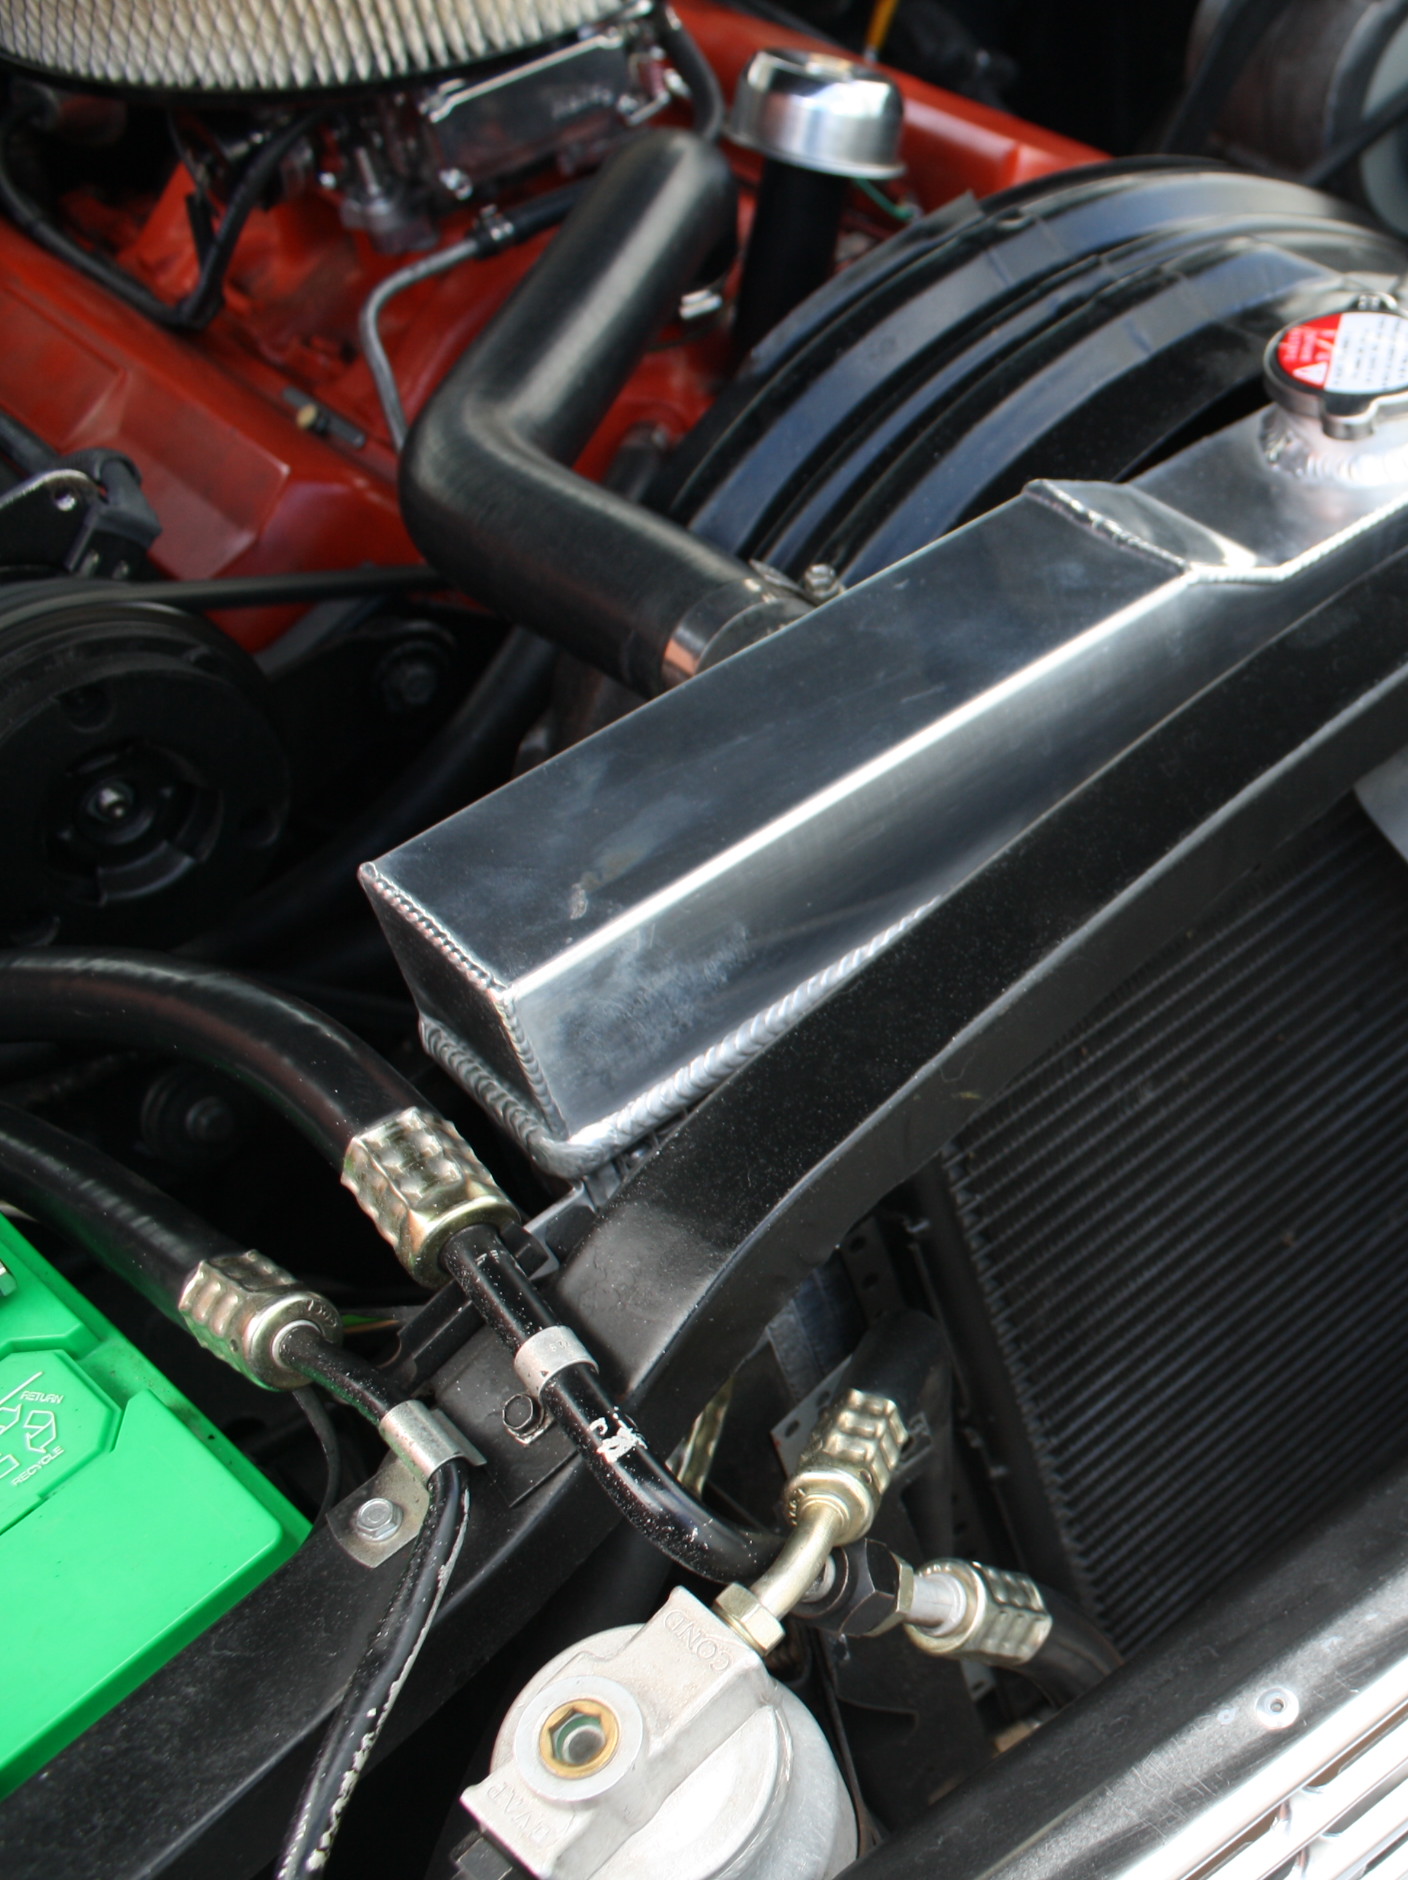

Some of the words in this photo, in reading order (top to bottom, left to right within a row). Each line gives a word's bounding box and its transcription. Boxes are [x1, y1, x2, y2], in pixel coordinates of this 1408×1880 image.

[20, 1390, 64, 1404] RETURN
[11, 1446, 64, 1486] RECYCLE
[664, 1609, 733, 1671] COND
